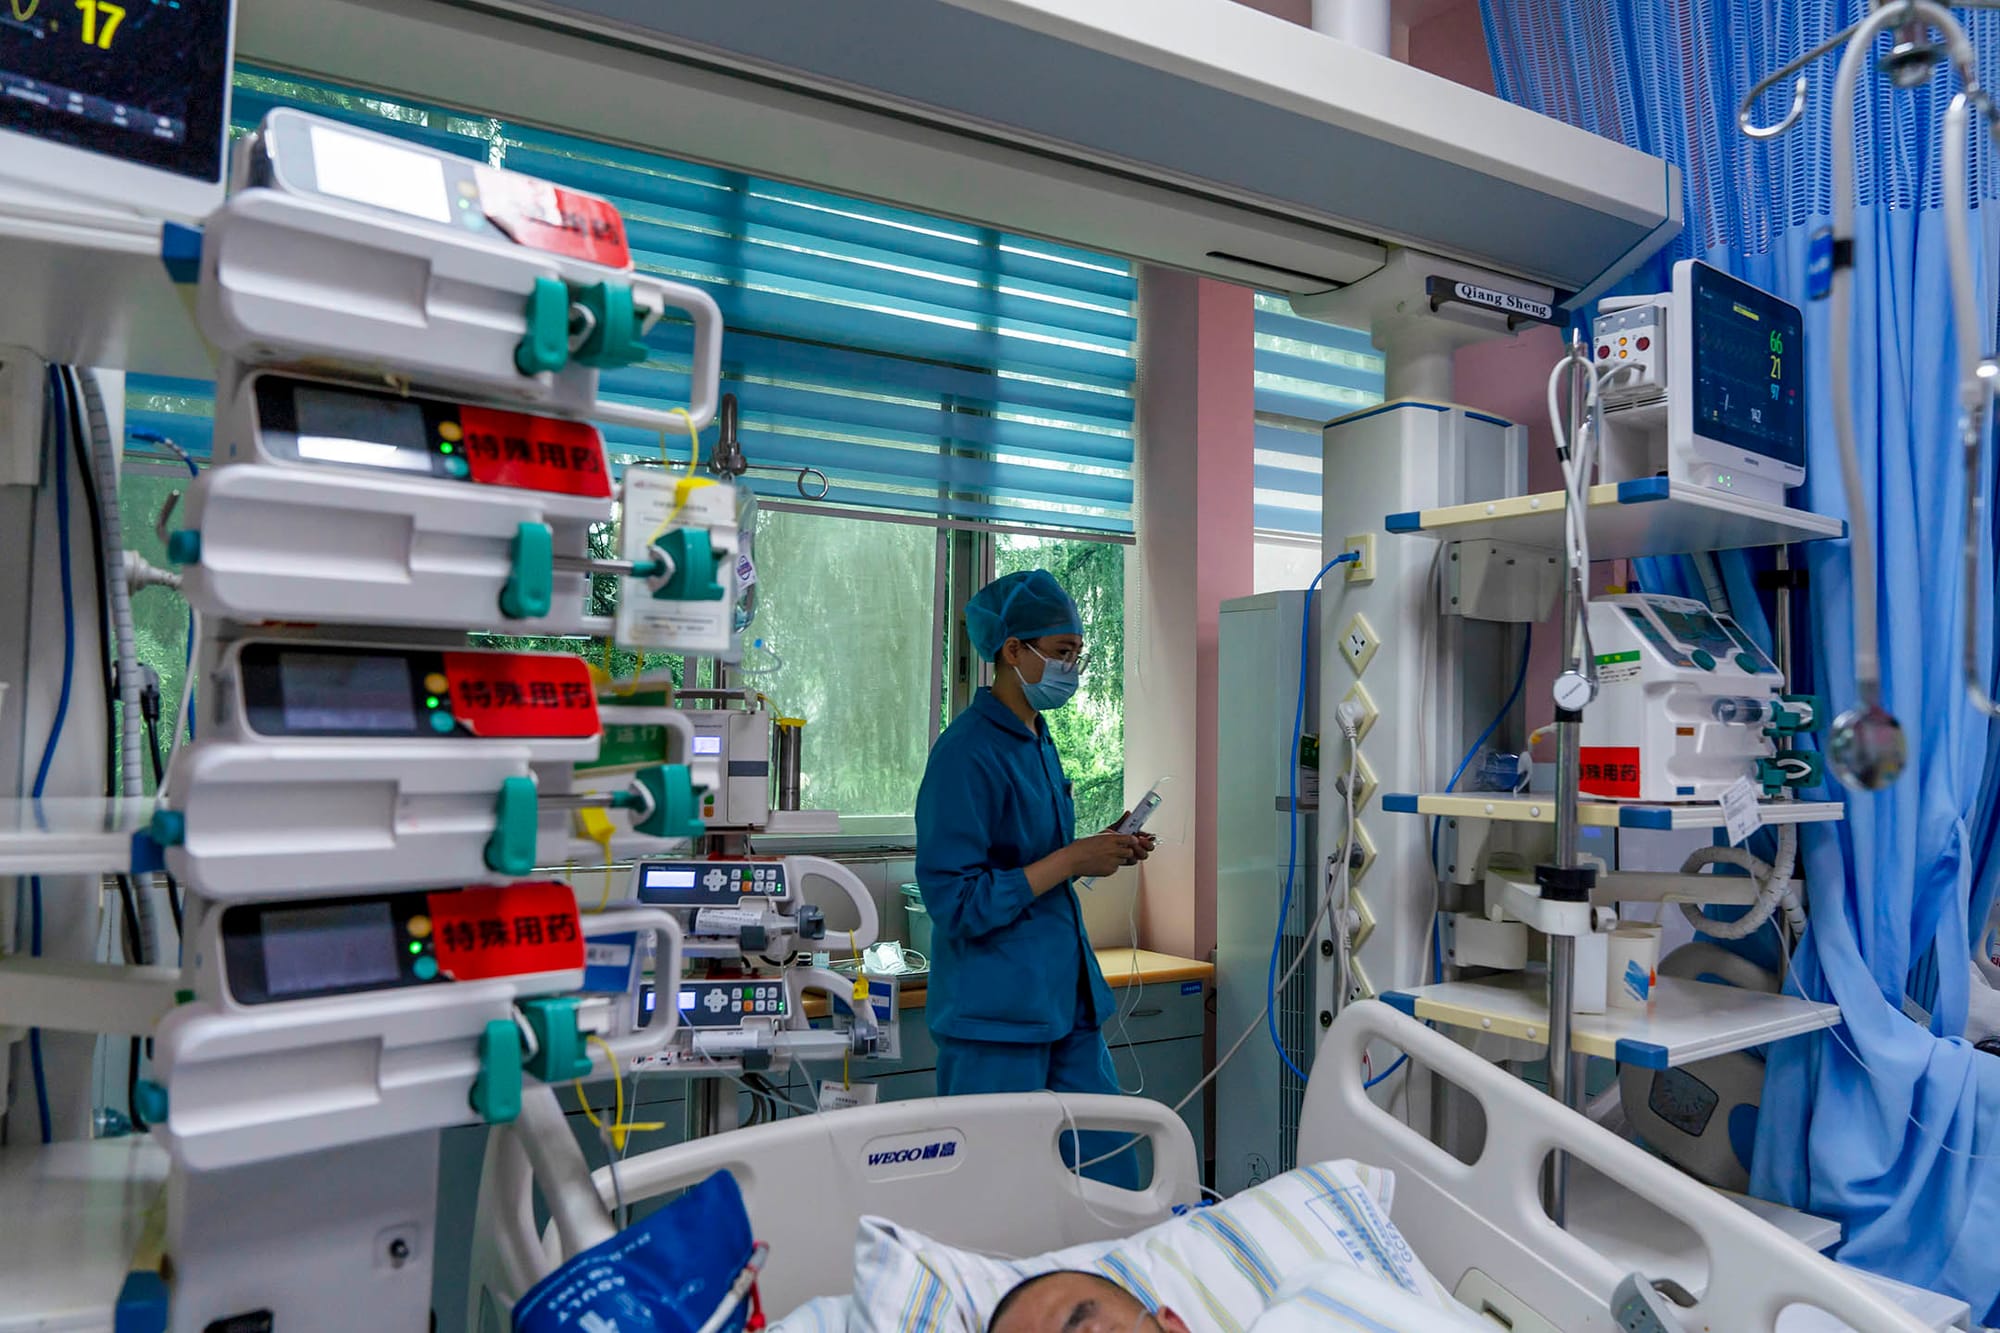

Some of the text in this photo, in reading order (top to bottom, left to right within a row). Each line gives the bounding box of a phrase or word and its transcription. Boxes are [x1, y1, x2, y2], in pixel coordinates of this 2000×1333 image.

[75, 0, 126, 49] 17
[1461, 285, 1546, 317] Qiang Sheng
[1769, 329, 1784, 355] 66
[1769, 354, 1782, 380] 21
[459, 678, 593, 710] 特殊用药
[443, 912, 578, 953] 特殊用药
[868, 1148, 922, 1167] WEGO
